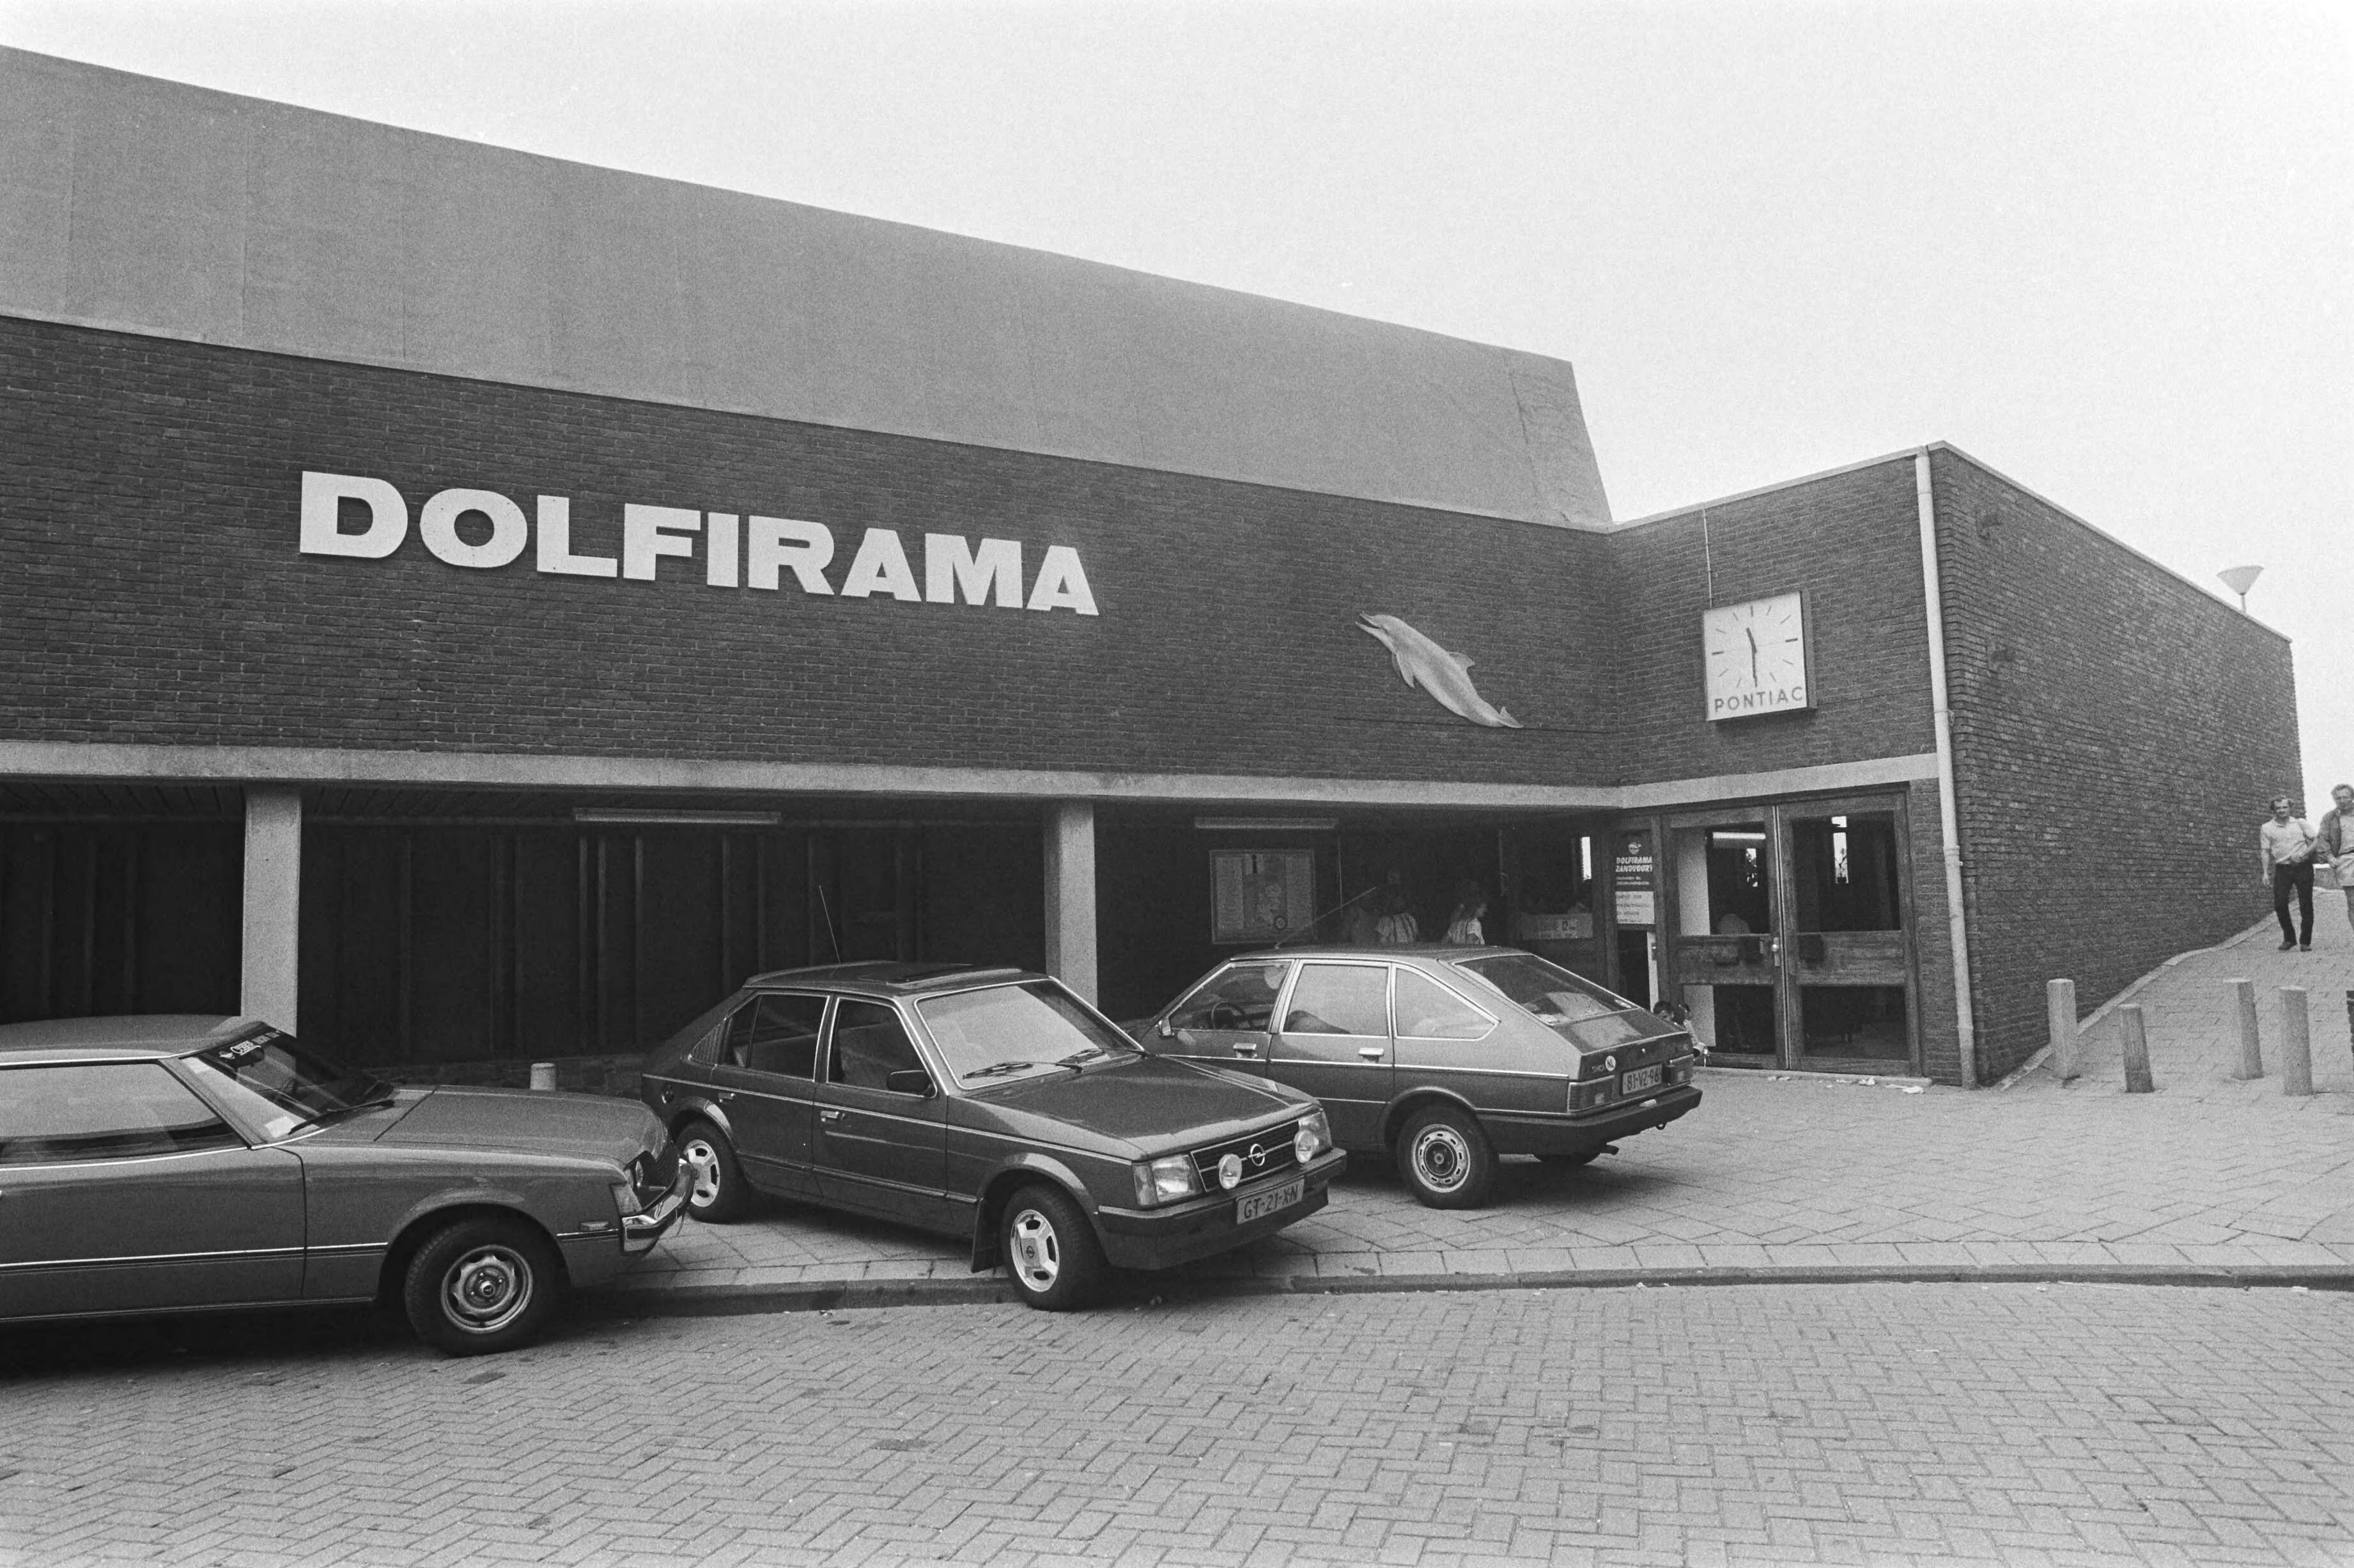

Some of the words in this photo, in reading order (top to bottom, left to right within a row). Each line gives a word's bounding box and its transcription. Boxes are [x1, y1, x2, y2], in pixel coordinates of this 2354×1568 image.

[300, 470, 1099, 616] DOLFIRAMA
[1714, 686, 1802, 712] PONTIAC
[1615, 864, 1652, 873] ZANDVOORT
[1616, 856, 1652, 864] DOLFIRAMA
